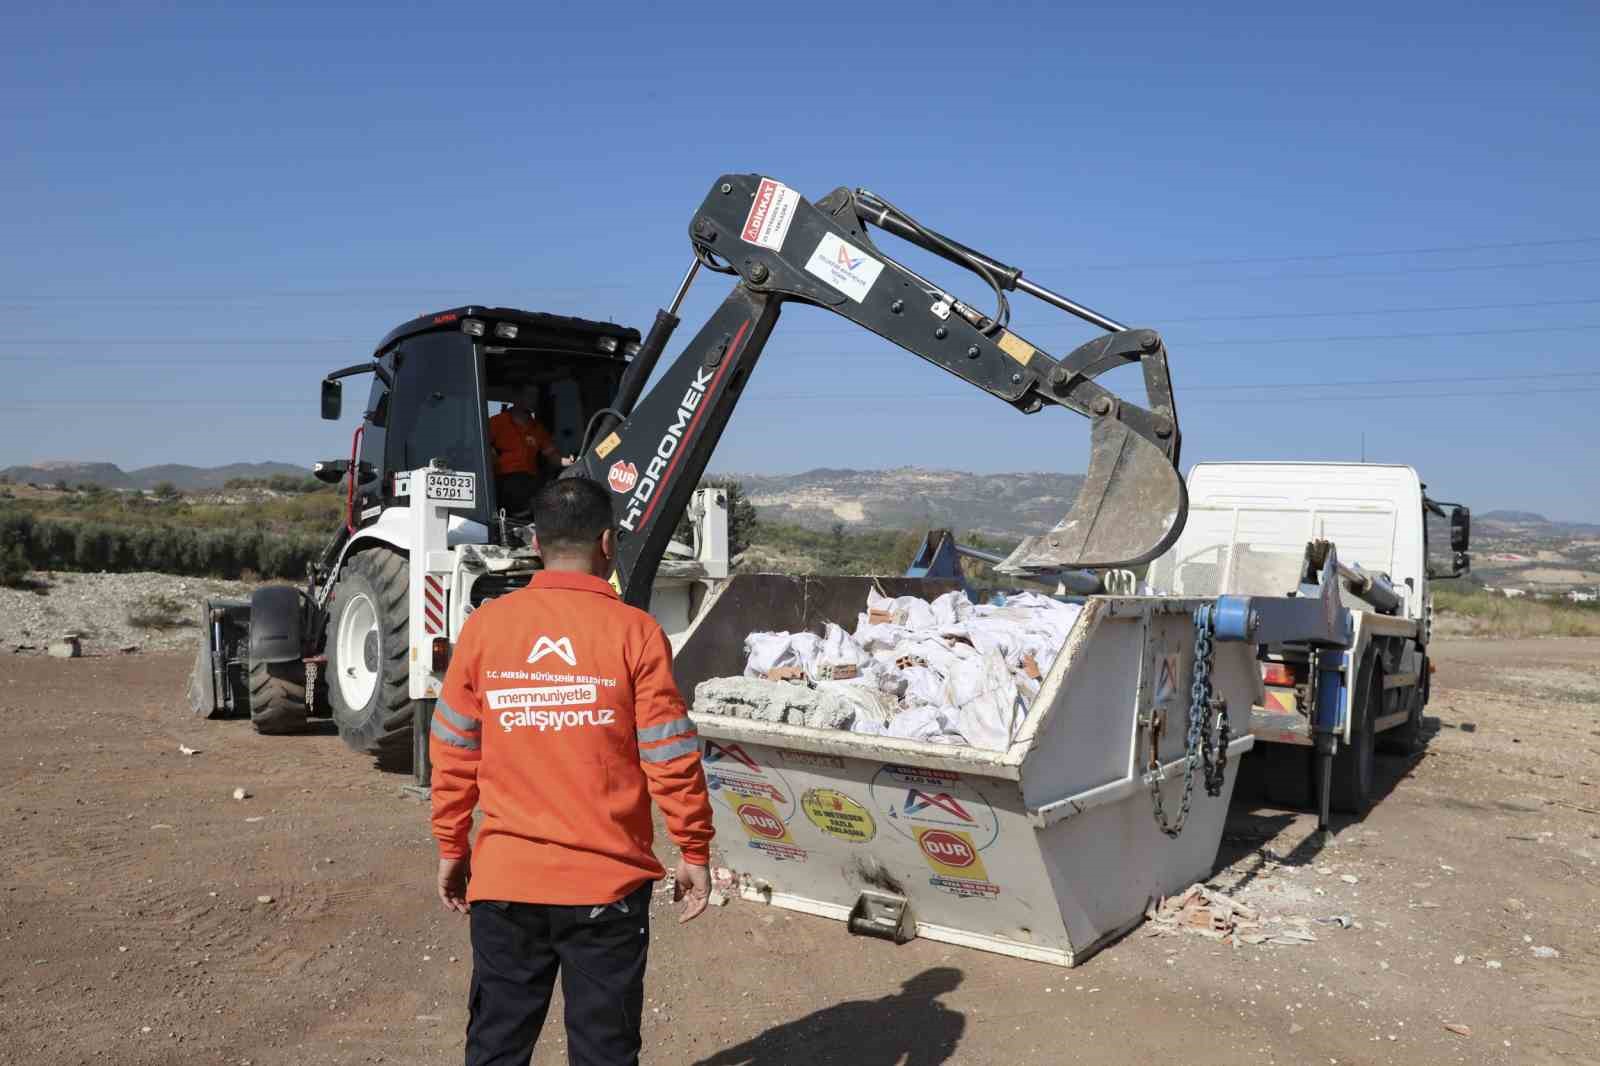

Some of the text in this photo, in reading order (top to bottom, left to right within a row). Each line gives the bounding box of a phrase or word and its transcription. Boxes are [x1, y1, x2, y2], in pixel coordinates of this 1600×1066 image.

[610, 468, 635, 485] DUR
[436, 487, 461, 498] 6701
[500, 670, 529, 680] MERSİN
[497, 687, 592, 705] memnuniyetle
[500, 706, 616, 732] çalışıyoruz
[744, 814, 779, 831] DUR
[926, 841, 969, 857] DUR
